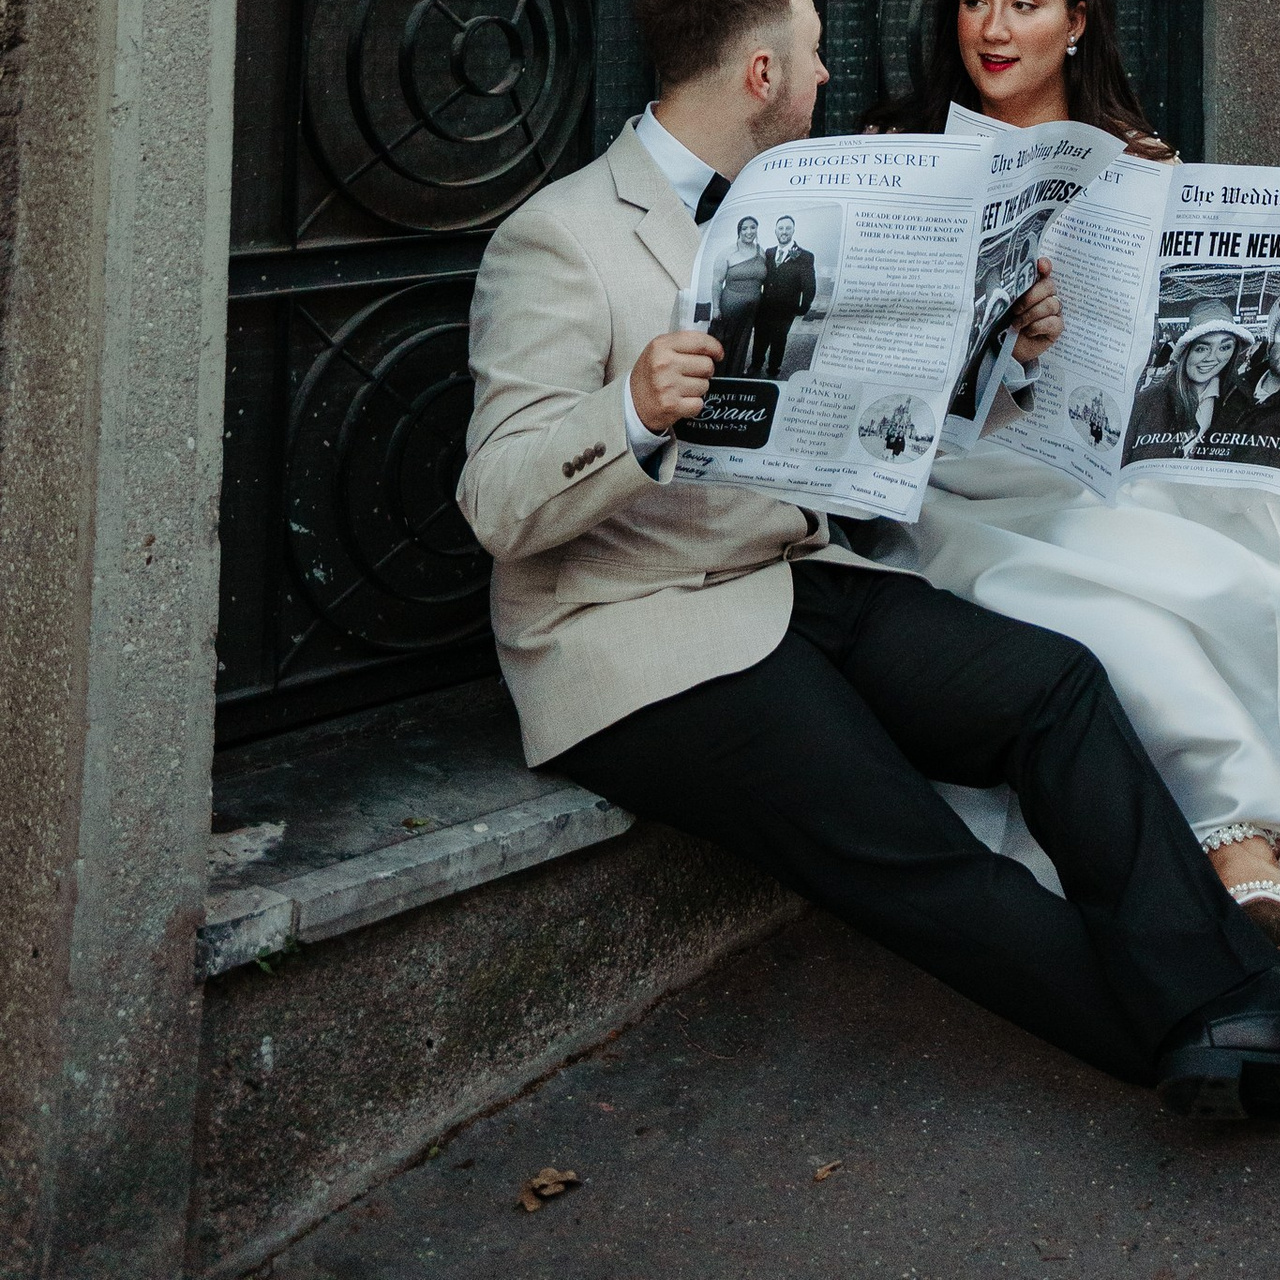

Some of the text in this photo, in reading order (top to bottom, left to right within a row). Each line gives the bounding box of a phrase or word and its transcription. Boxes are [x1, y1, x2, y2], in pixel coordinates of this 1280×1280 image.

[763, 153, 939, 171] THE BIGGEST SECRET
[991, 154, 1013, 176] The
[1052, 140, 1092, 159] Post
[789, 174, 902, 187] OF THE YEAR
[1181, 185, 1214, 206] The
[924, 216, 951, 224] JORDAN
[981, 201, 1002, 233] EET
[1002, 195, 1020, 226] THE
[856, 221, 893, 229] GERIANNE
[1159, 231, 1204, 257] MEET
[1209, 232, 1242, 257] THE
[820, 381, 842, 389] special
[739, 394, 756, 402] THE
[801, 387, 830, 397] THANK
[691, 398, 768, 422] Evans
[820, 401, 841, 410] family
[818, 431, 844, 439] through
[1132, 432, 1190, 449] JORDAN
[1209, 448, 1230, 456] 2025
[675, 466, 708, 477] emory
[729, 455, 743, 463] Ben
[873, 472, 899, 484] Grampa
[900, 479, 918, 489] Brian
